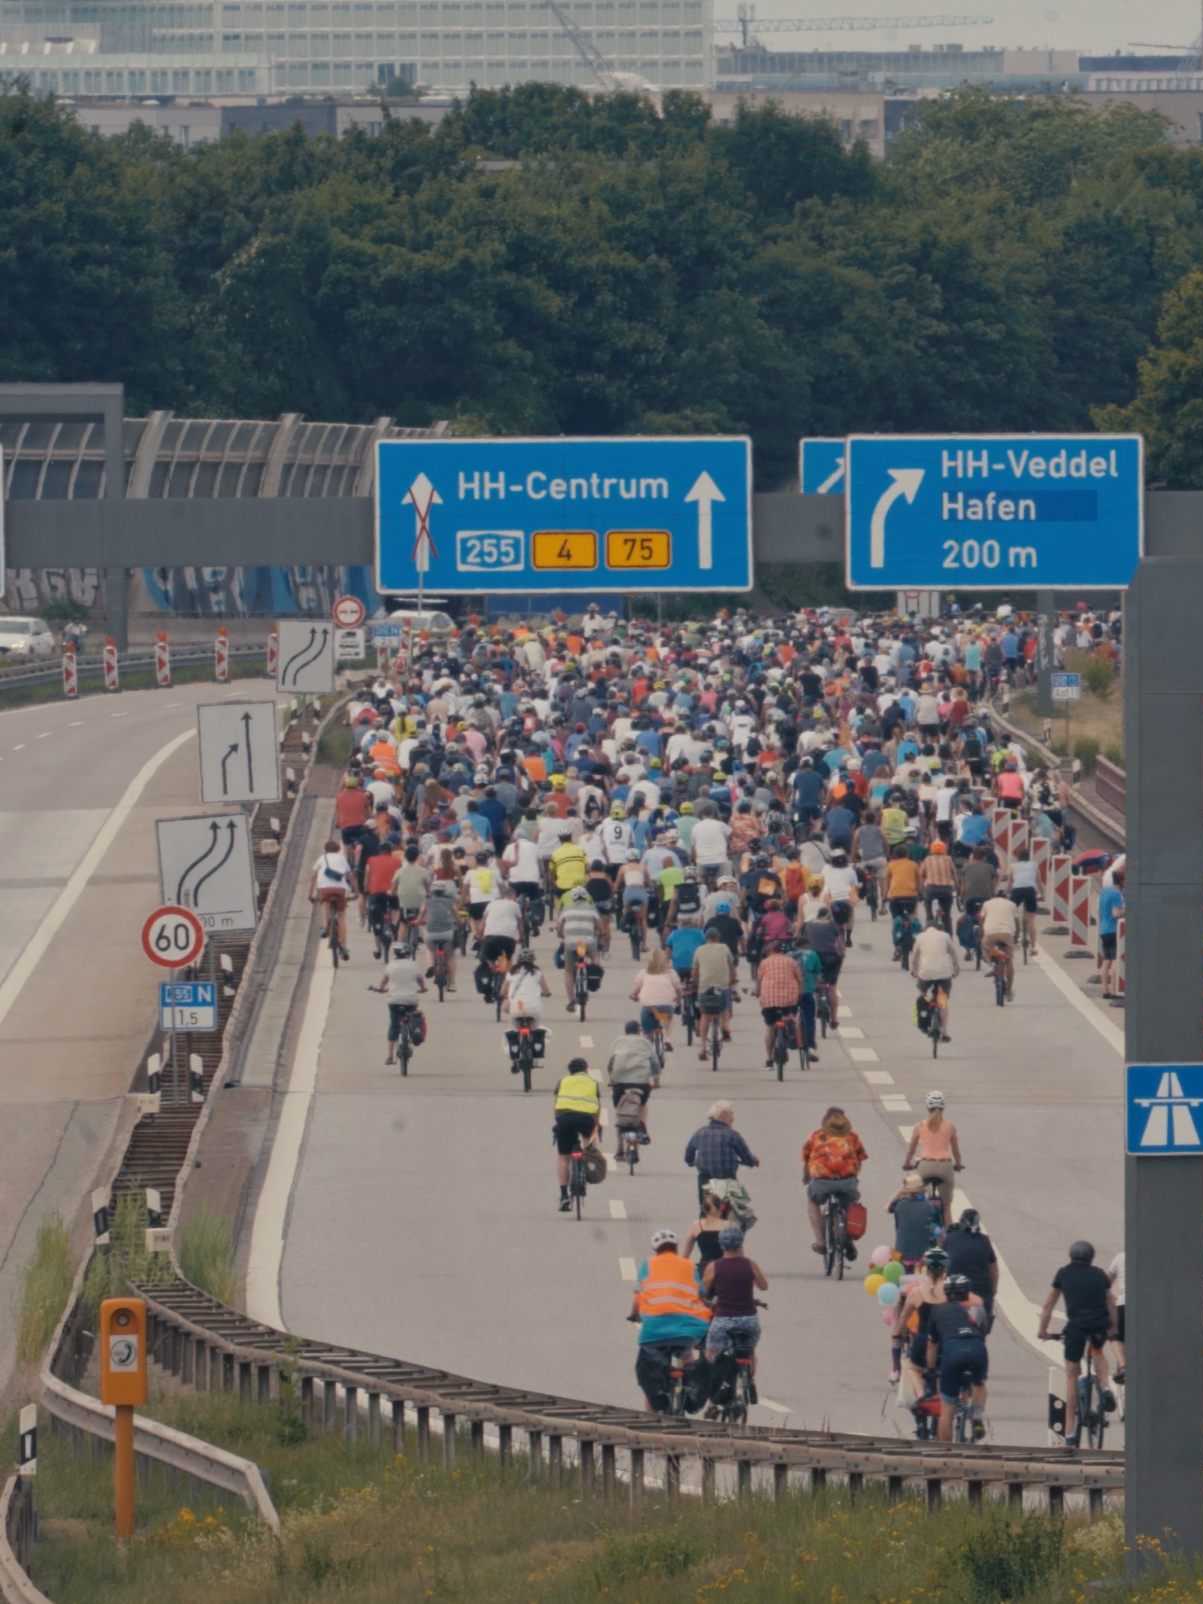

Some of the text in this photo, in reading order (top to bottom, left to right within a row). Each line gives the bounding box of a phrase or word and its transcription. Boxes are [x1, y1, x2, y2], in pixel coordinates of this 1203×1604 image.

[941, 449, 1119, 479] HH-Veddel
[458, 471, 669, 500] HH-Centrum
[942, 492, 1036, 521] Hafen
[466, 538, 653, 563] 255 4 75
[942, 539, 1038, 568] 200 m
[614, 825, 623, 840] 9
[221, 917, 234, 926] m
[155, 923, 190, 952] 60
[198, 986, 211, 1002] N
